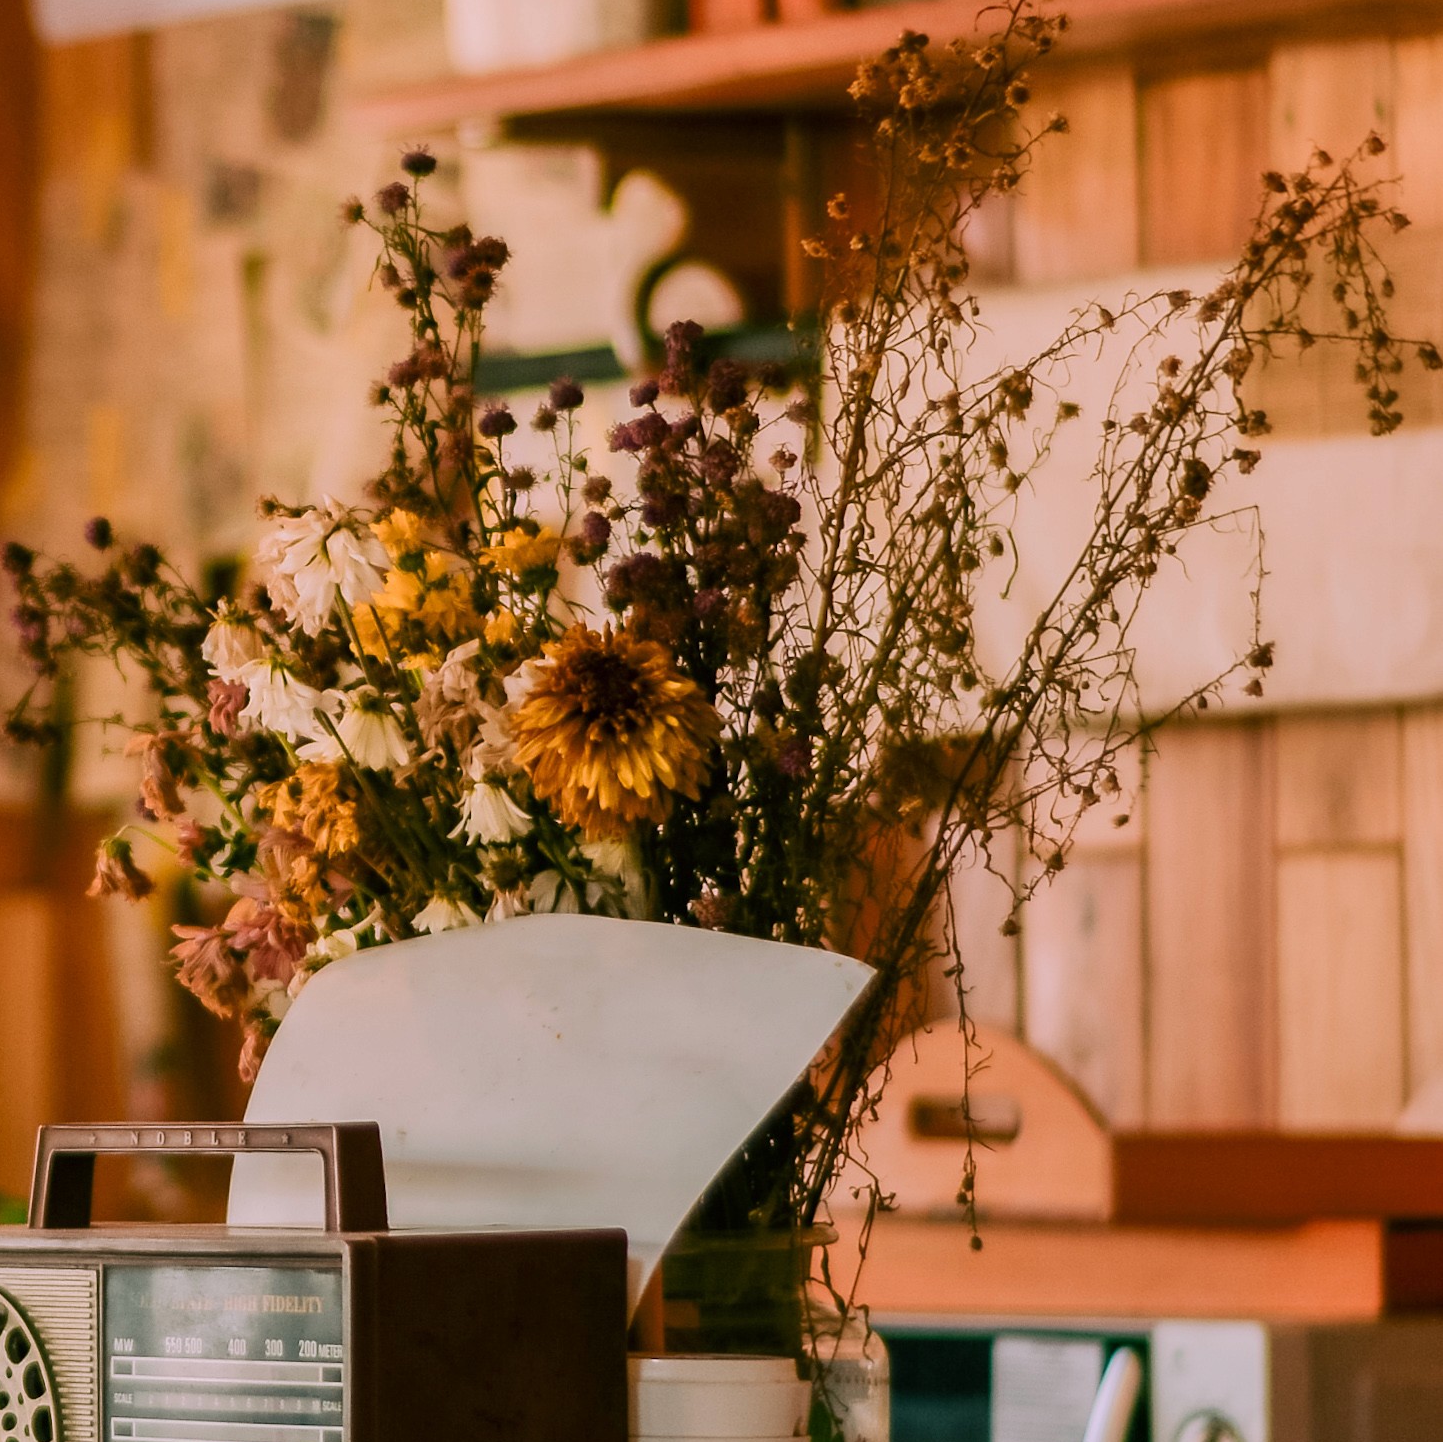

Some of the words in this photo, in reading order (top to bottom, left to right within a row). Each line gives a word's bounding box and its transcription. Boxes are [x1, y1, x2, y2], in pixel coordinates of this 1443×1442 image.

[130, 1130, 246, 1146] NOBLE
[224, 1295, 258, 1312] HIGH
[262, 1294, 323, 1314] FIDELITY
[113, 1336, 134, 1352] MW
[165, 1336, 182, 1354] 550
[184, 1336, 203, 1355] 500
[228, 1338, 246, 1356] 400
[264, 1338, 283, 1357] 300
[298, 1339, 317, 1358] 200
[113, 1392, 133, 1404] SCALE
[322, 1400, 342, 1411] SCALE
